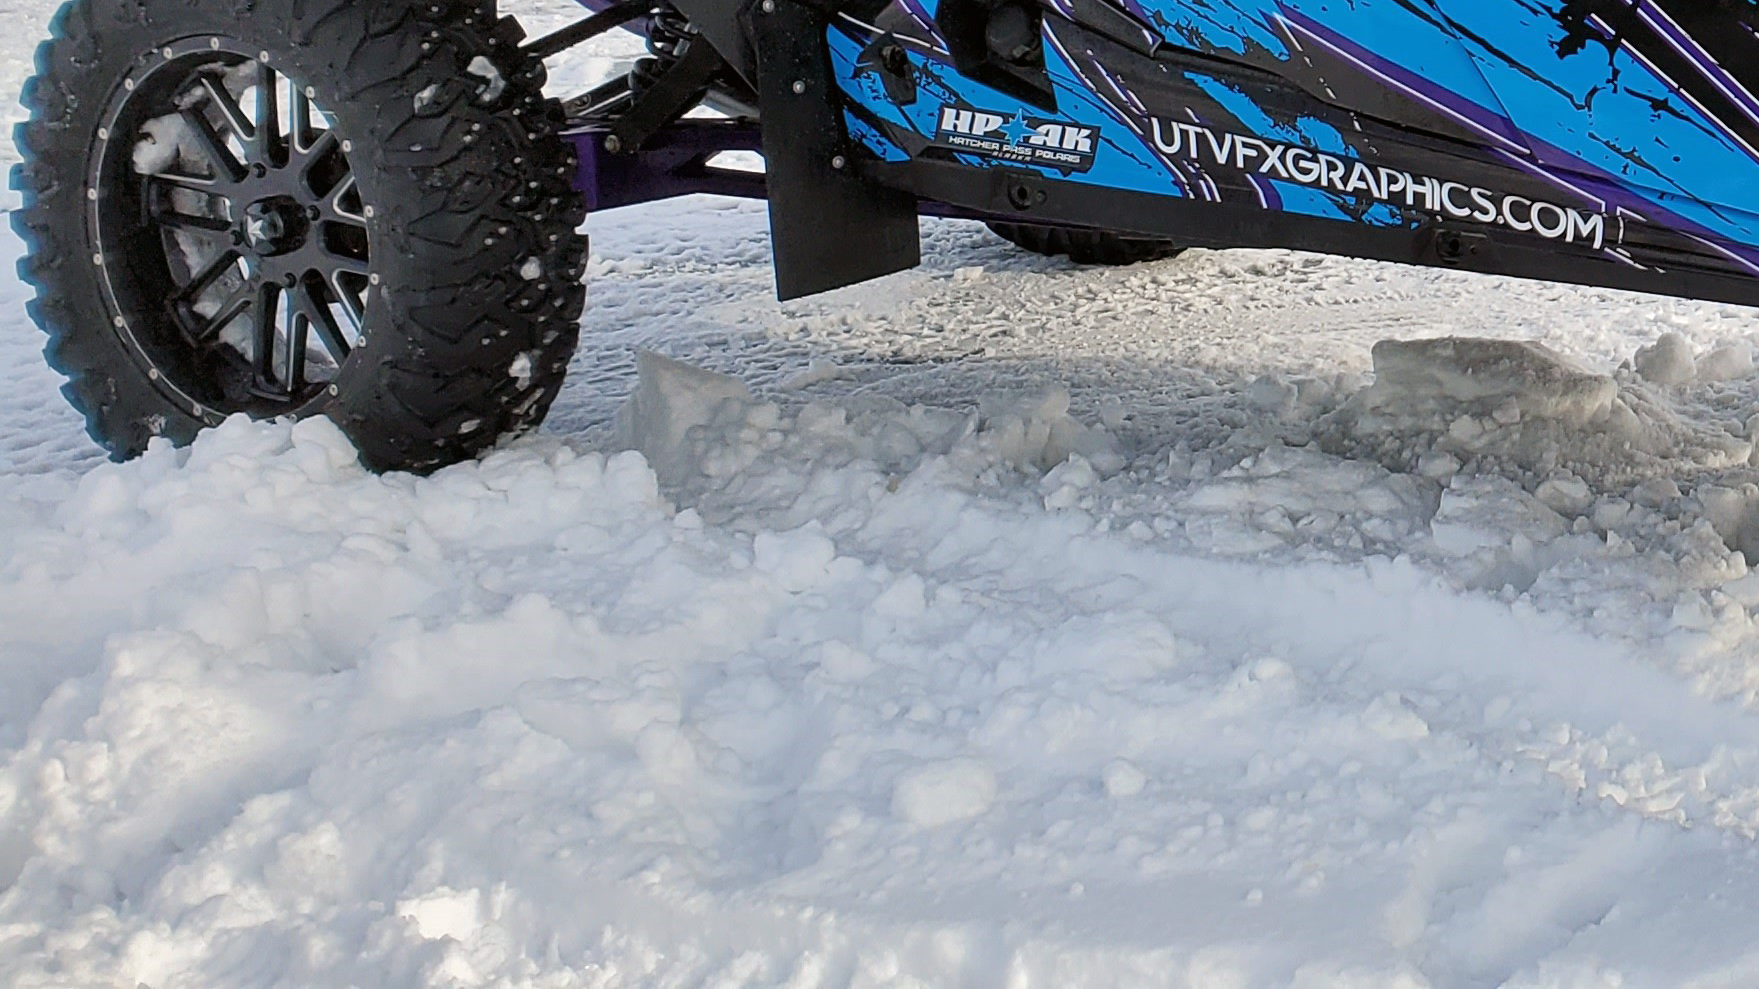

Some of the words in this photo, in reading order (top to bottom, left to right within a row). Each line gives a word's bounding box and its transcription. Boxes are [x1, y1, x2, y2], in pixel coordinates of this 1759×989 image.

[949, 135, 1000, 151] HATCHER
[1003, 143, 1033, 156] PASS
[1035, 149, 1081, 164] POLARIS
[1149, 116, 1605, 249] UTVFXGRAPHICS.COM
